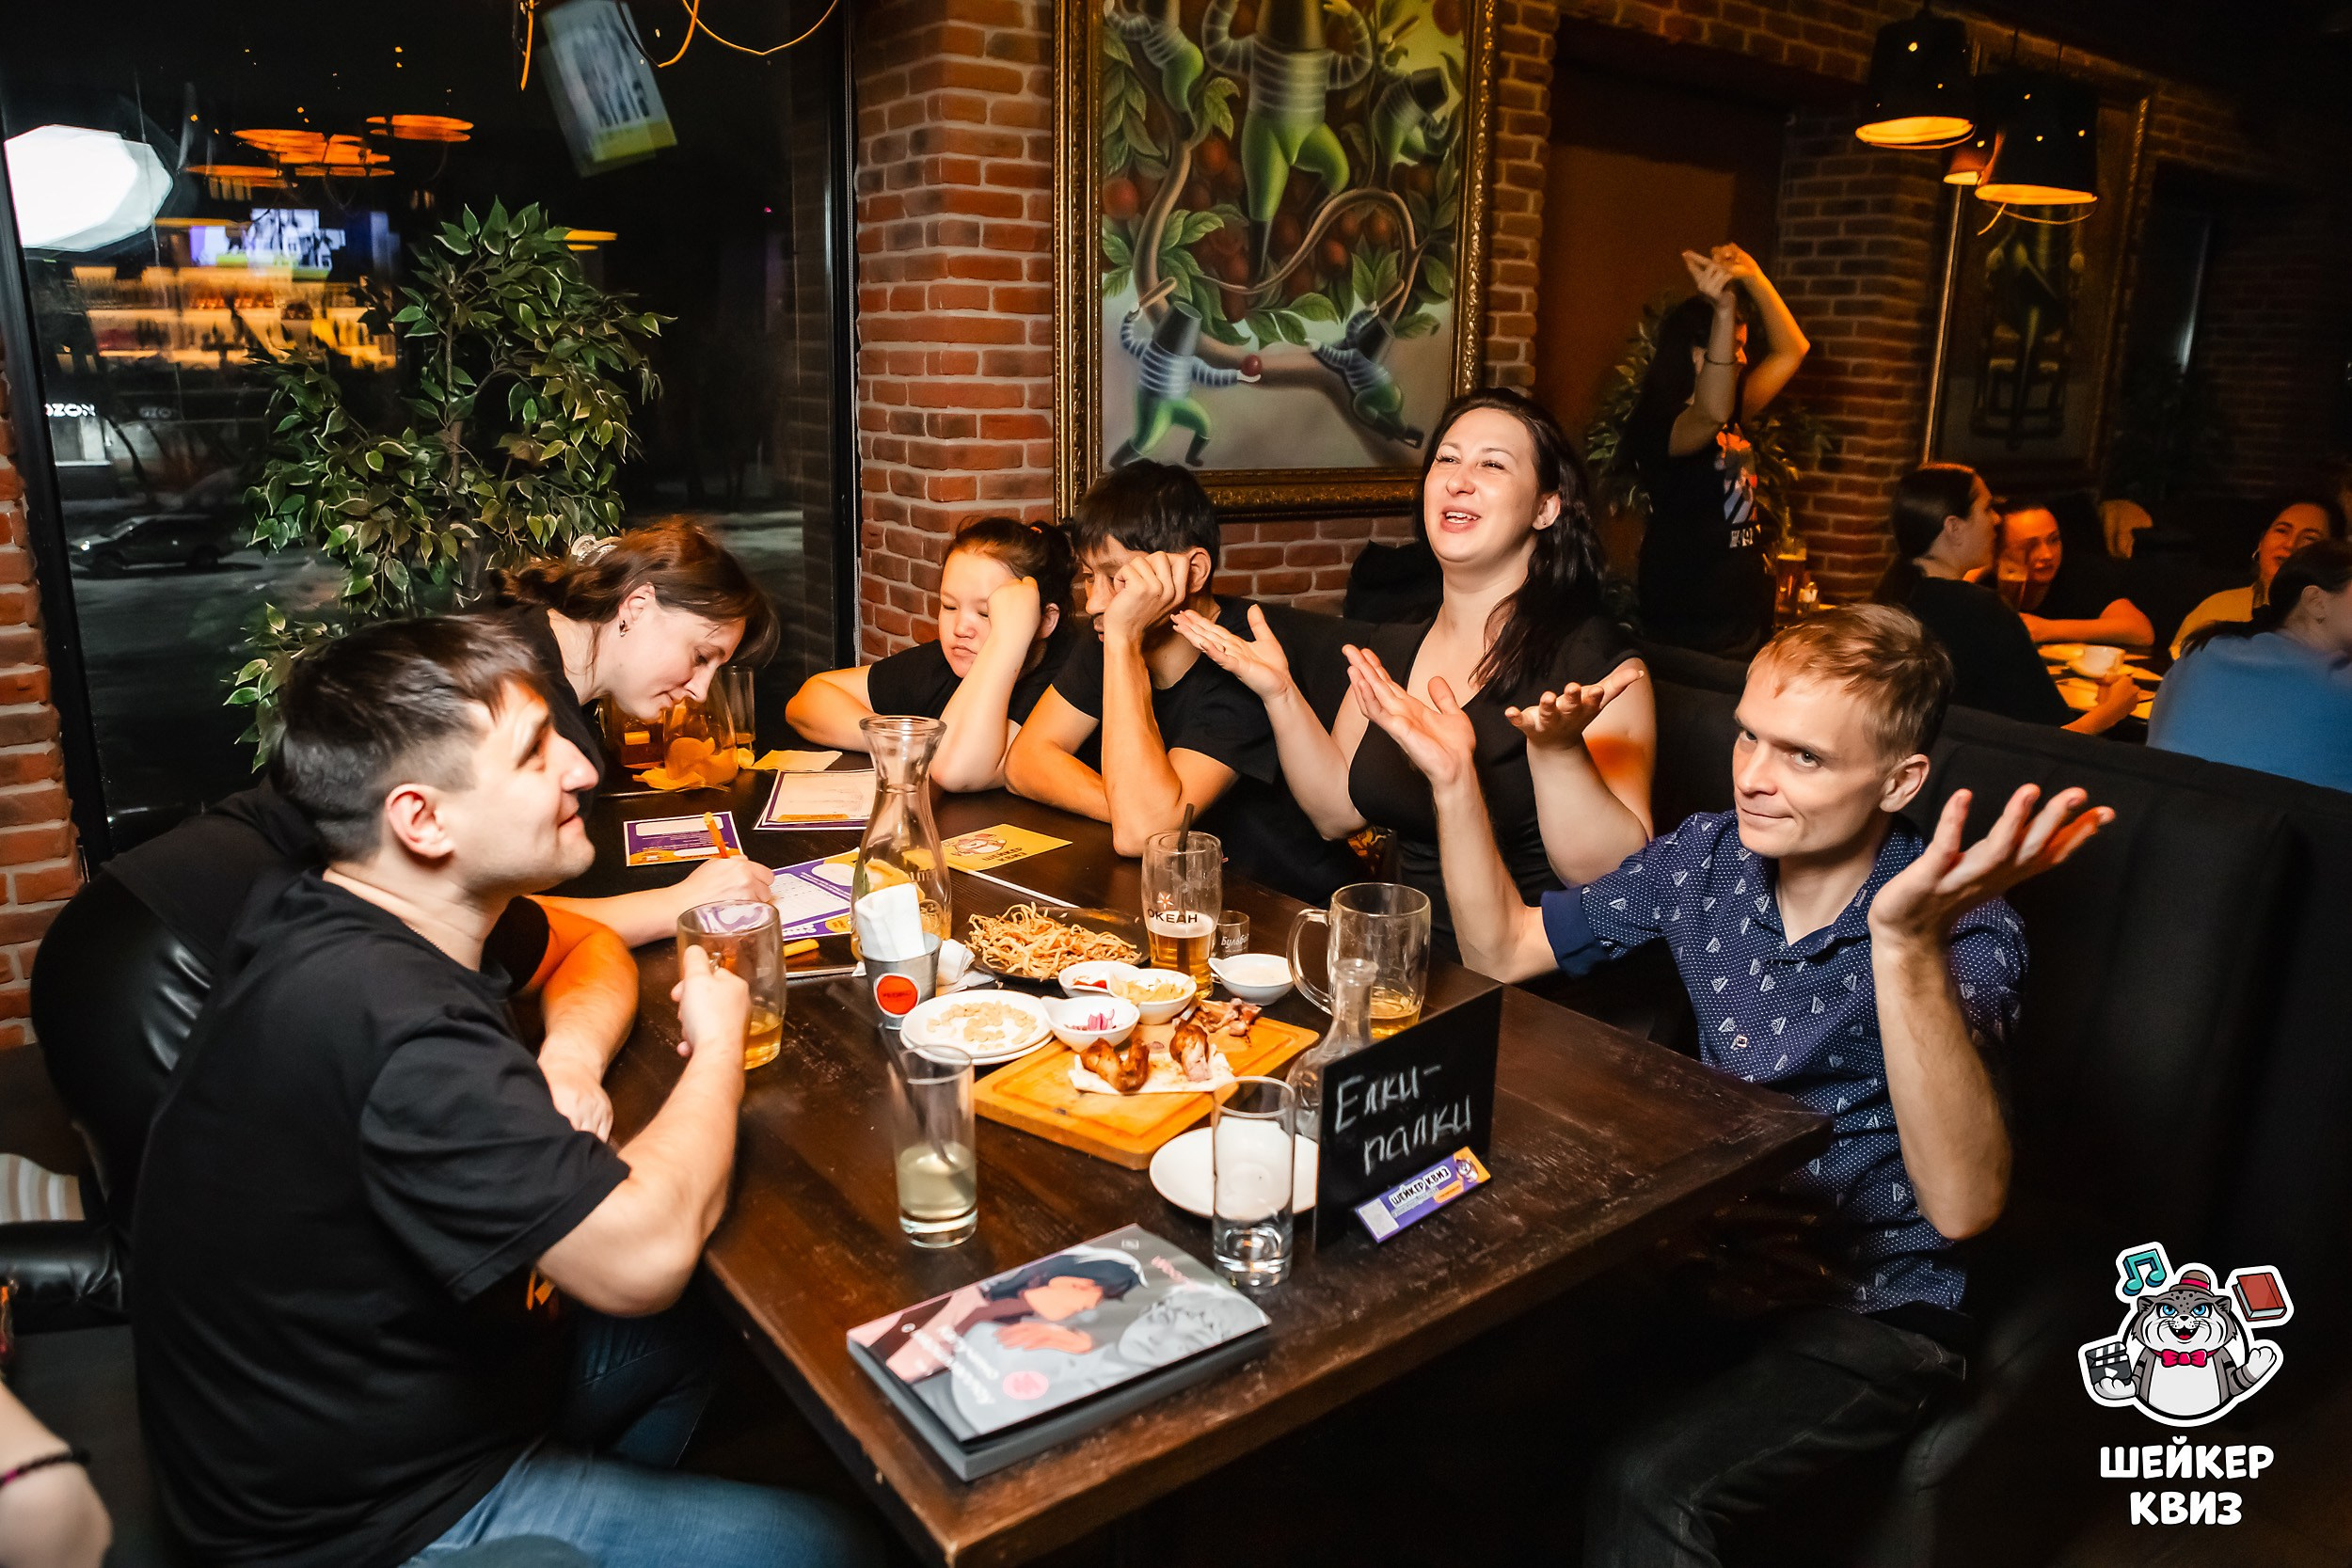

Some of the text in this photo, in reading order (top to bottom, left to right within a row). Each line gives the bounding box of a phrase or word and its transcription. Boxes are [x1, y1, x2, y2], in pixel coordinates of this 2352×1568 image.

[1148, 909, 1198, 923] ОКЕАН
[1363, 1094, 1472, 1177] палки
[1391, 1181, 1425, 1205] ШЕЙКЕР
[1425, 1168, 1450, 1188] КВИЗ
